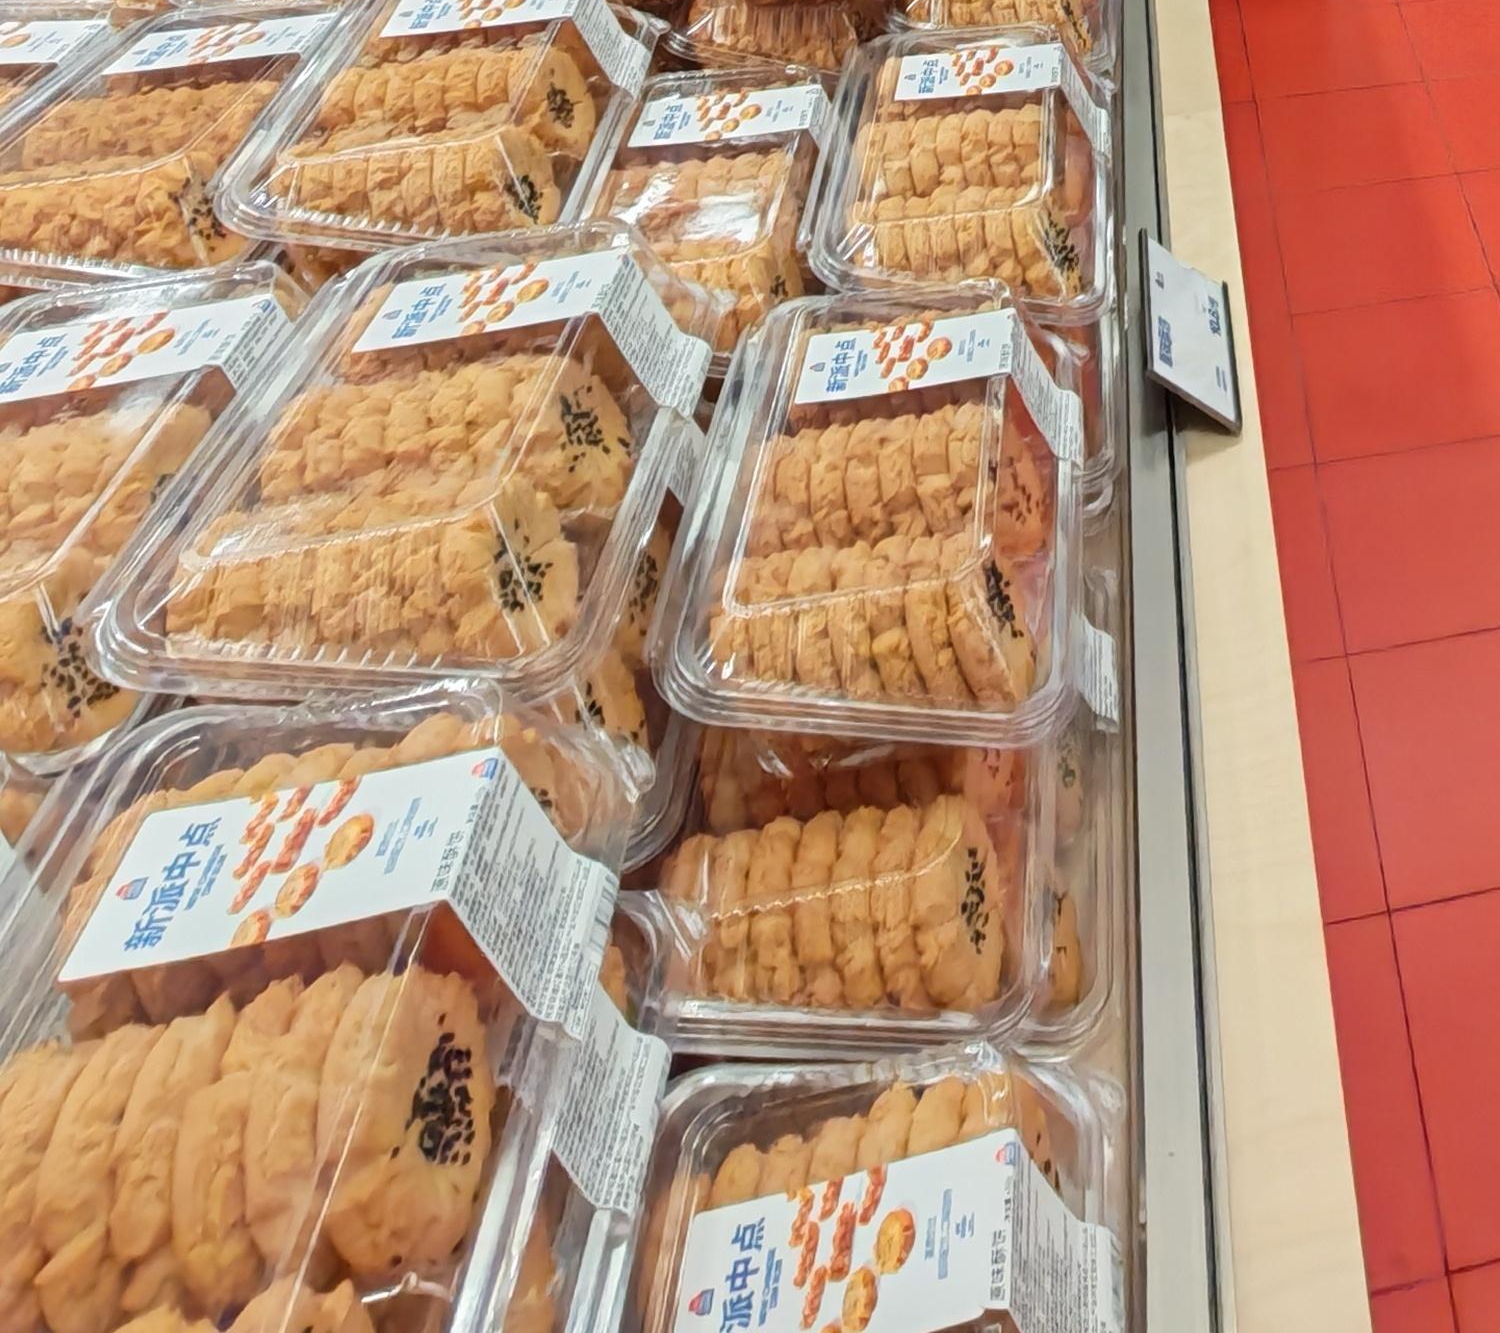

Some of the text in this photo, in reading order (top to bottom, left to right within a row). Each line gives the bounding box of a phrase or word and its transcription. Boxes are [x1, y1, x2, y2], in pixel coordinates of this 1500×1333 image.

[825, 337, 857, 393] 新派中点
[124, 817, 222, 951] 新派中点
